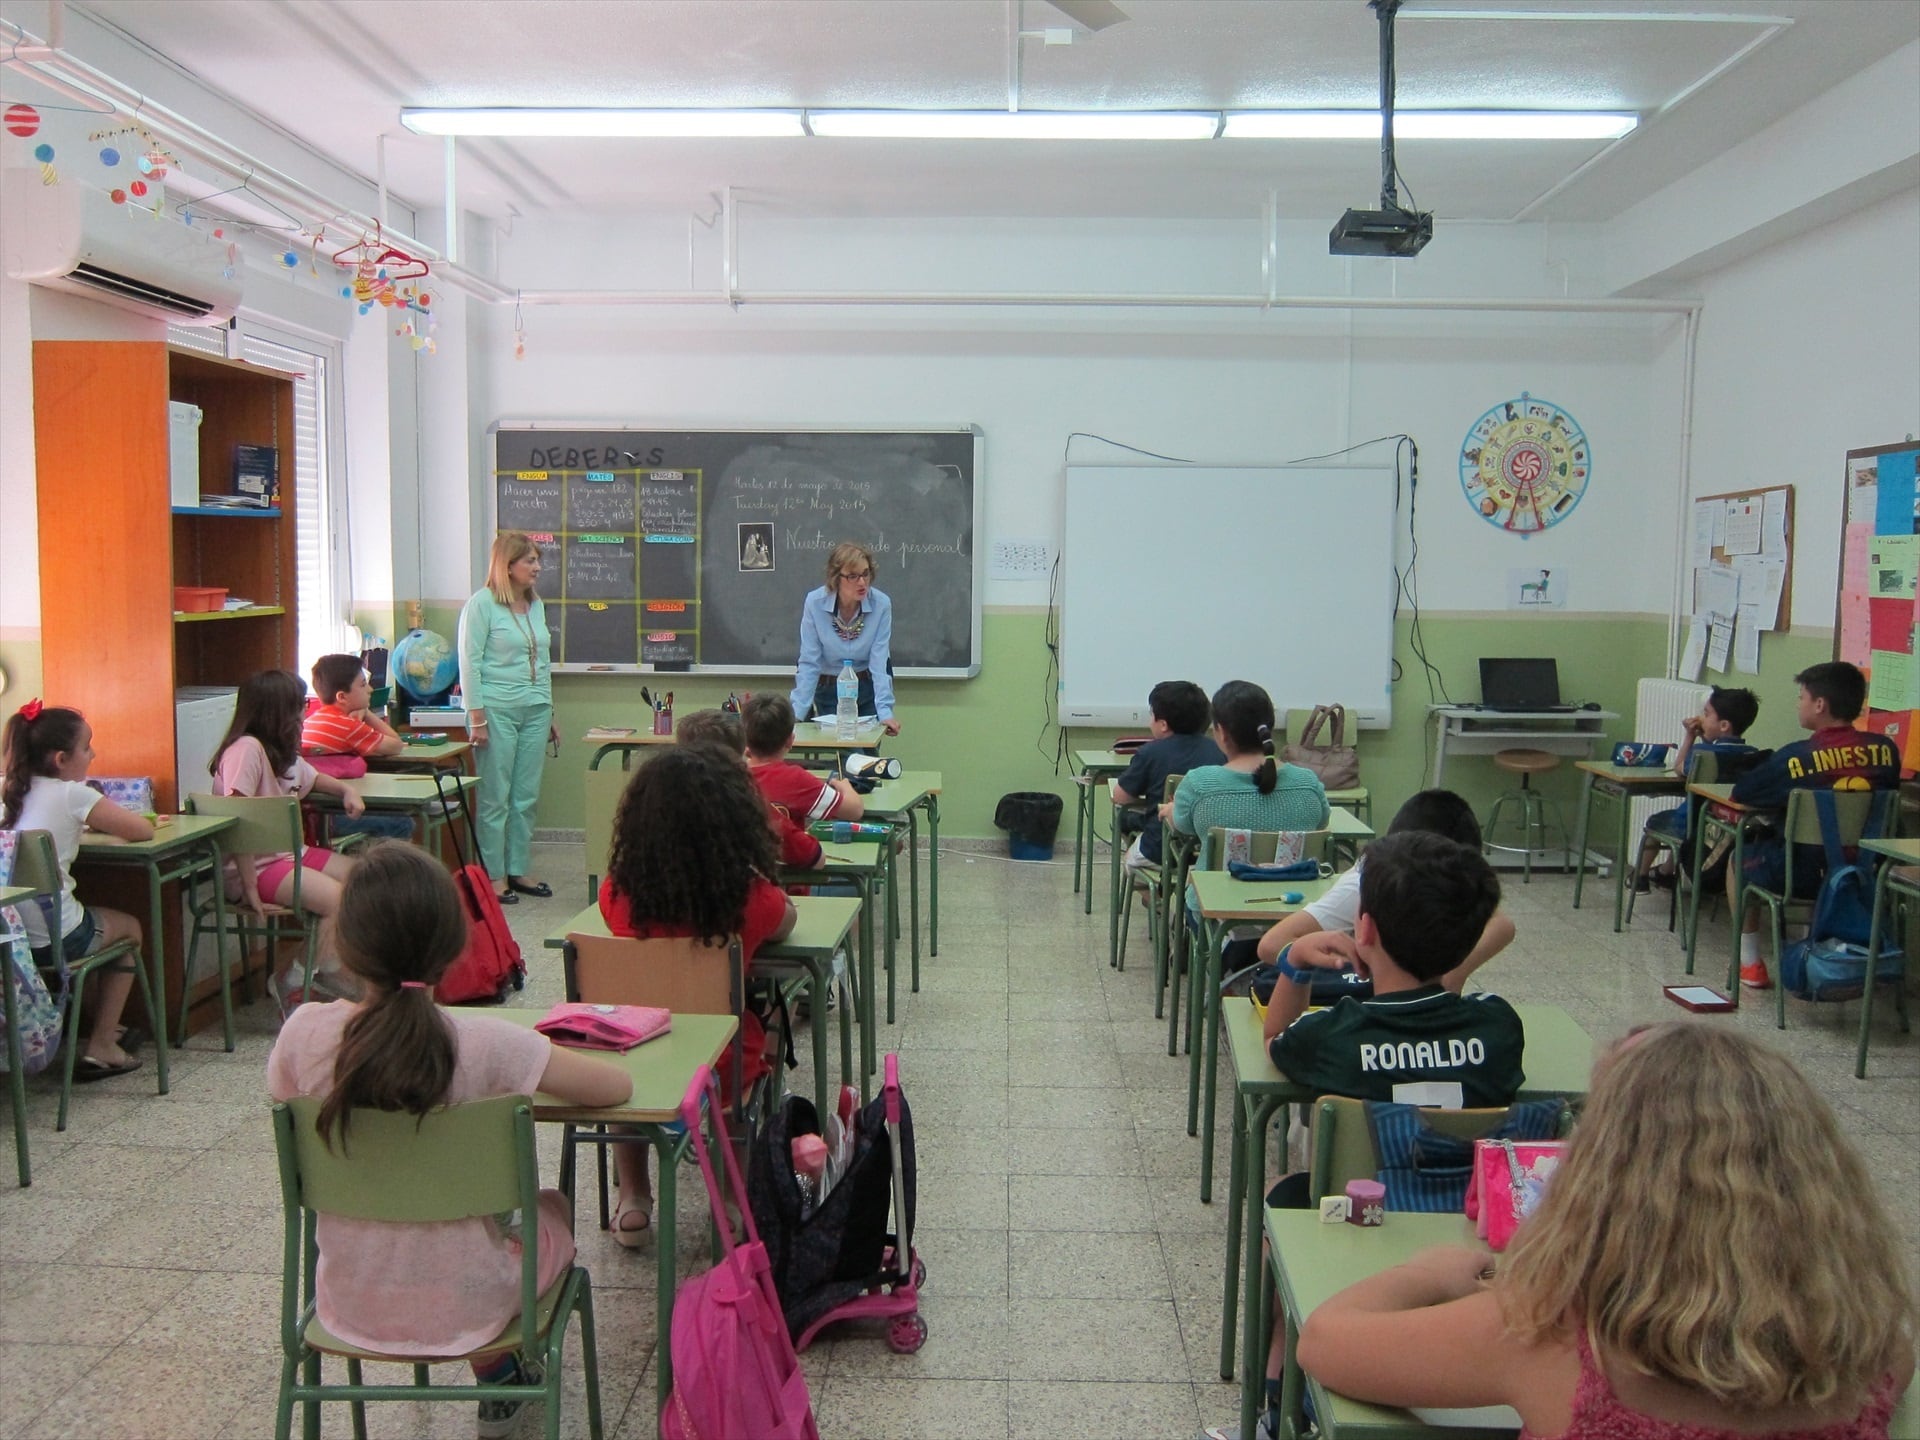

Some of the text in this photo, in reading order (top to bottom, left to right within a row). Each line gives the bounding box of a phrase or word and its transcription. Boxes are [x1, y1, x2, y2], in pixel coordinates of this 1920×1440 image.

[587, 472, 613, 481] MATES
[730, 494, 779, 517] Tuesday
[810, 496, 834, 520] May
[839, 499, 867, 513] 2015
[786, 525, 836, 551] Nuestro
[896, 534, 966, 568] personal
[1359, 1037, 1485, 1072] RONALDO
